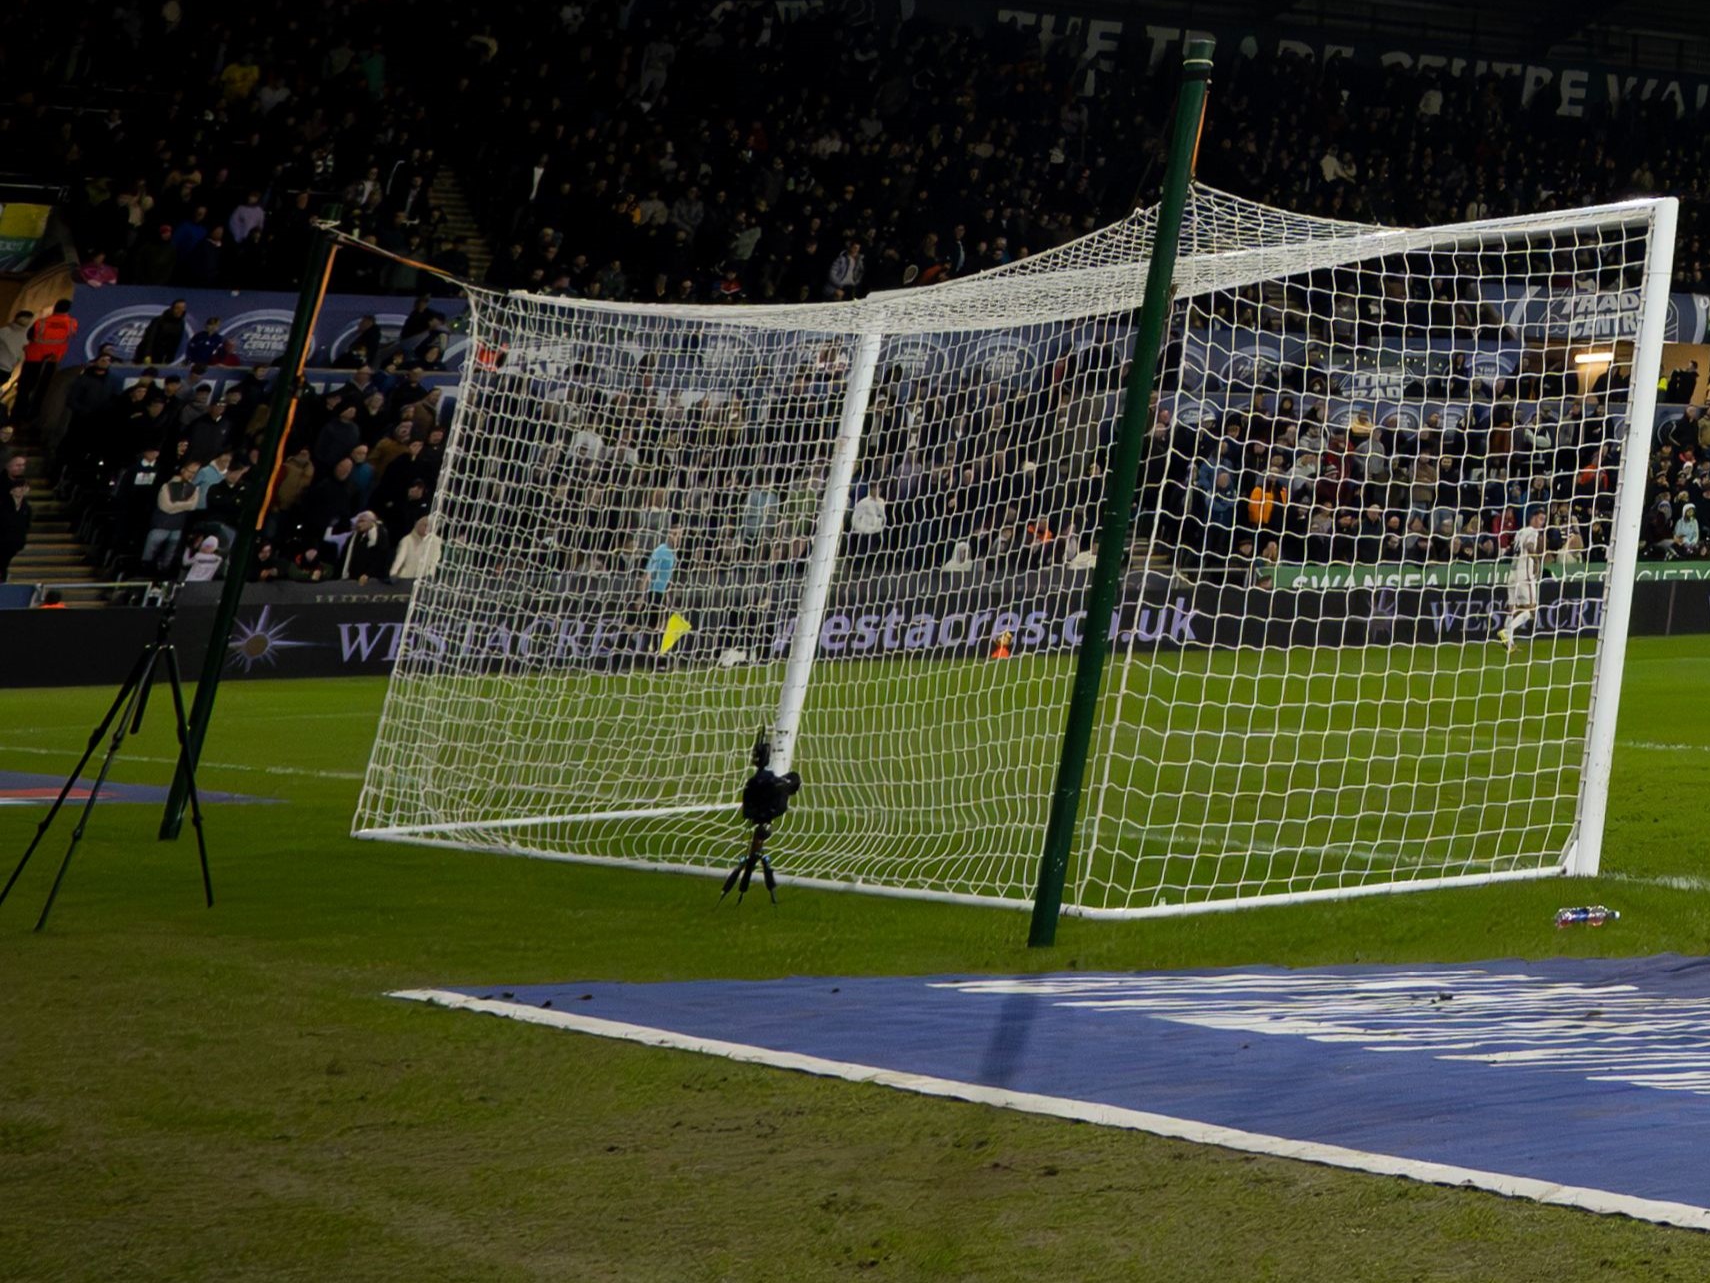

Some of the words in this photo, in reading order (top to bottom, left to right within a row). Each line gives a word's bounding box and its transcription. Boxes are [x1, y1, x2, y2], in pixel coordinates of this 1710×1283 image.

[1562, 294, 1641, 314] TRAD
[1568, 315, 1642, 338] CENTR
[772, 596, 1197, 656] westacres.c.uk
[1429, 594, 1604, 634] WESACRE
[337, 620, 648, 664] WESTACRE
